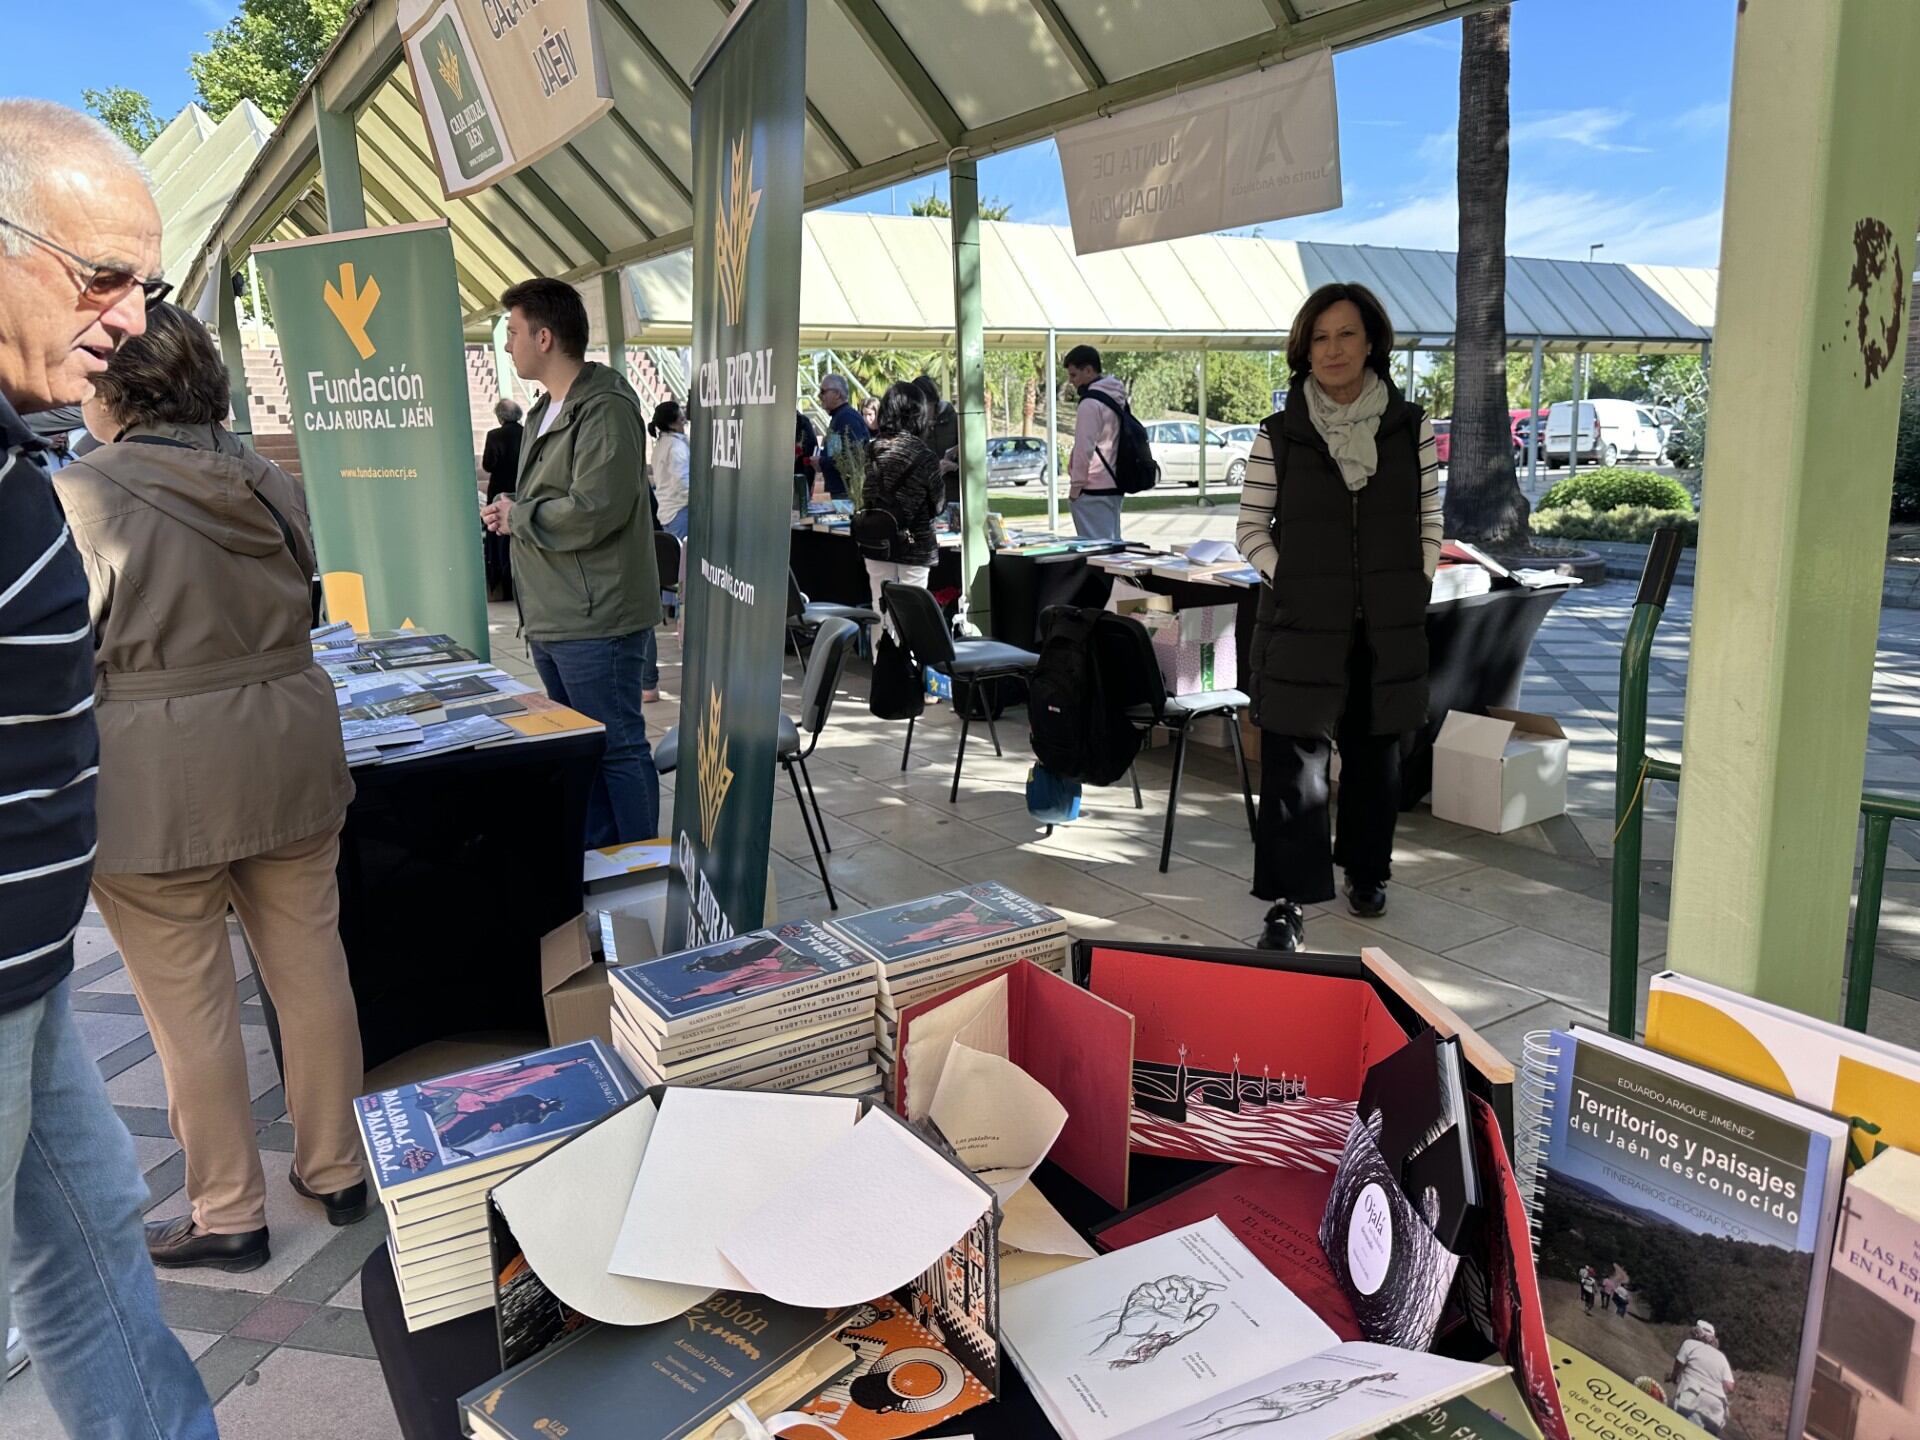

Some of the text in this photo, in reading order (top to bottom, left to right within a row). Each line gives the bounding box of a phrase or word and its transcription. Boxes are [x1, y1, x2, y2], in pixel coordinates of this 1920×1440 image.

[533, 27, 577, 97] JAÉN
[307, 363, 424, 404] Fundación
[700, 348, 776, 408] CAJA RURAL
[304, 401, 434, 431] CAJA RURAL JAÉN
[711, 408, 744, 469] JAÉN
[1617, 1077, 1755, 1140] EDUARDO ARAQUE JIMÉNEZ
[1569, 1114, 1799, 1225] del Jaén desconocido
[1577, 1089, 1797, 1200] Territorios y paisajes
[1364, 1194, 1386, 1236] Ojalá
[1601, 1166, 1750, 1242] ITINERARIOS GEOGRÁFICOS
[1241, 1215, 1259, 1231] EL
[1262, 1228, 1306, 1257] SALTO
[1862, 1238, 1894, 1266] LAS
[1849, 1250, 1872, 1273] EN
[1876, 1267, 1897, 1291] LA
[706, 1290, 768, 1336] abón
[1569, 1390, 1589, 1405] que
[1590, 1403, 1602, 1414] te
[1586, 1378, 1686, 1440] Quieres
